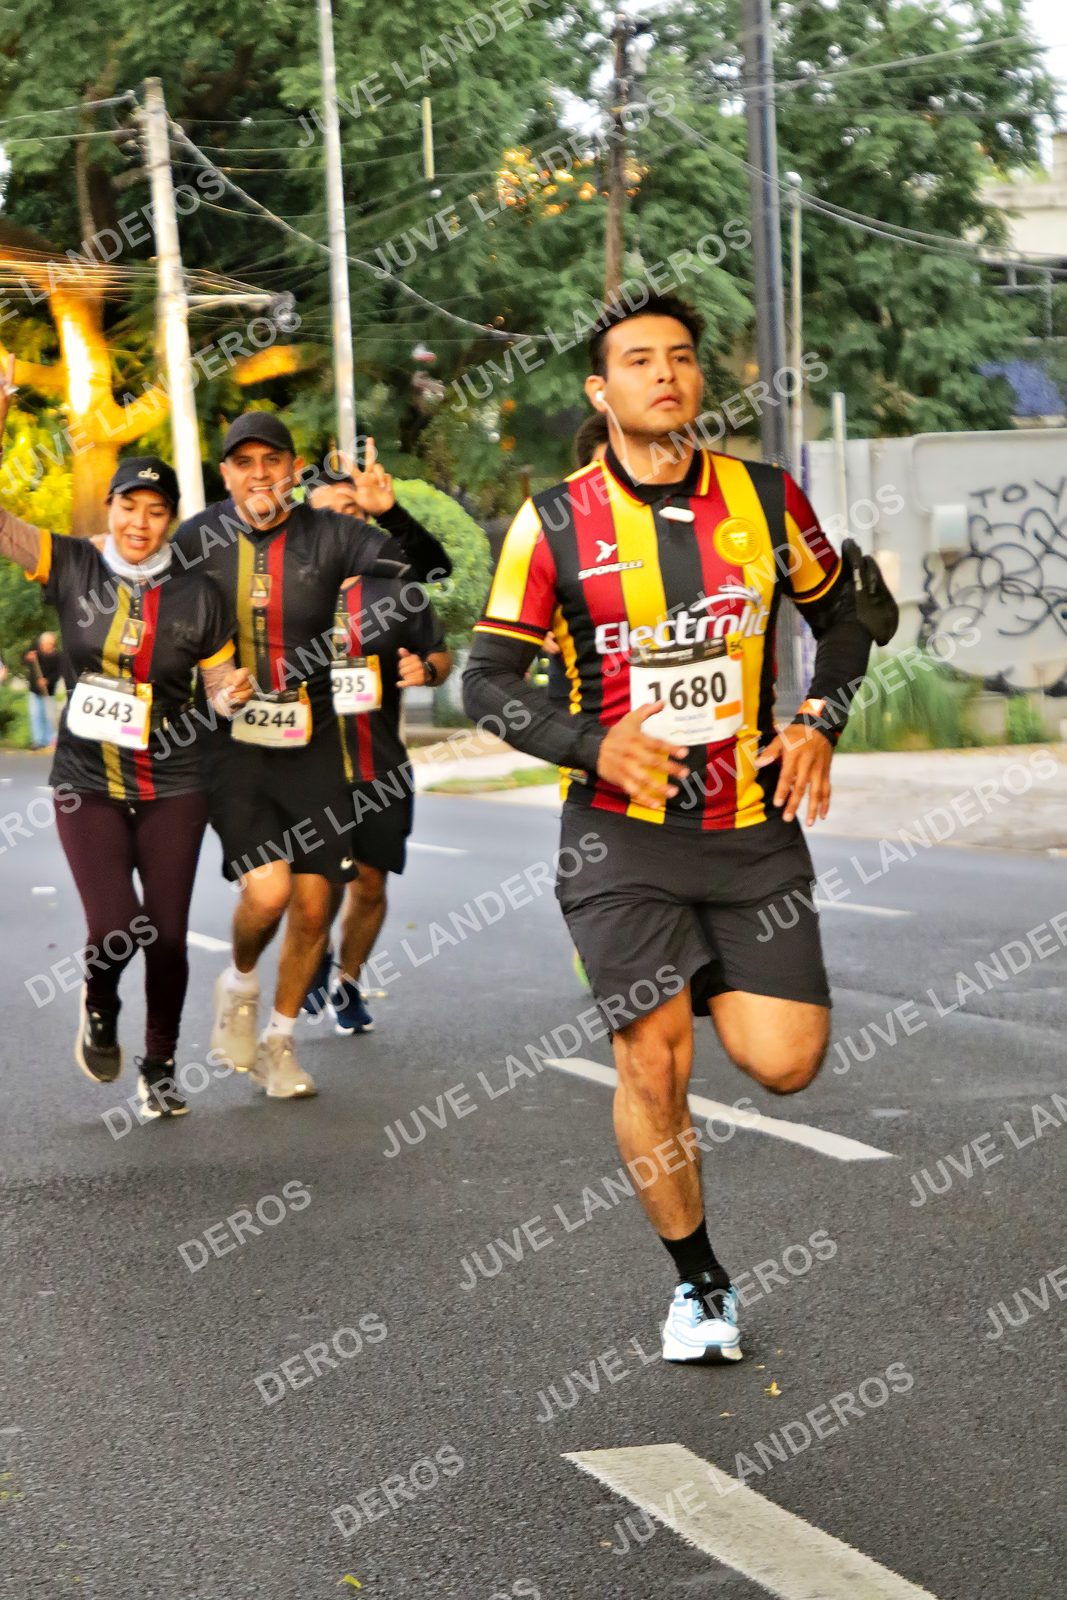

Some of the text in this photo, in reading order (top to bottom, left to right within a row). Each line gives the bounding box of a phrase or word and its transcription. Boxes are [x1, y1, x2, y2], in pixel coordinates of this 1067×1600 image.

[594, 605, 770, 655] Electrolit
[647, 671, 727, 711] 1680
[82, 696, 134, 724] 6243
[244, 708, 297, 728] 6244
